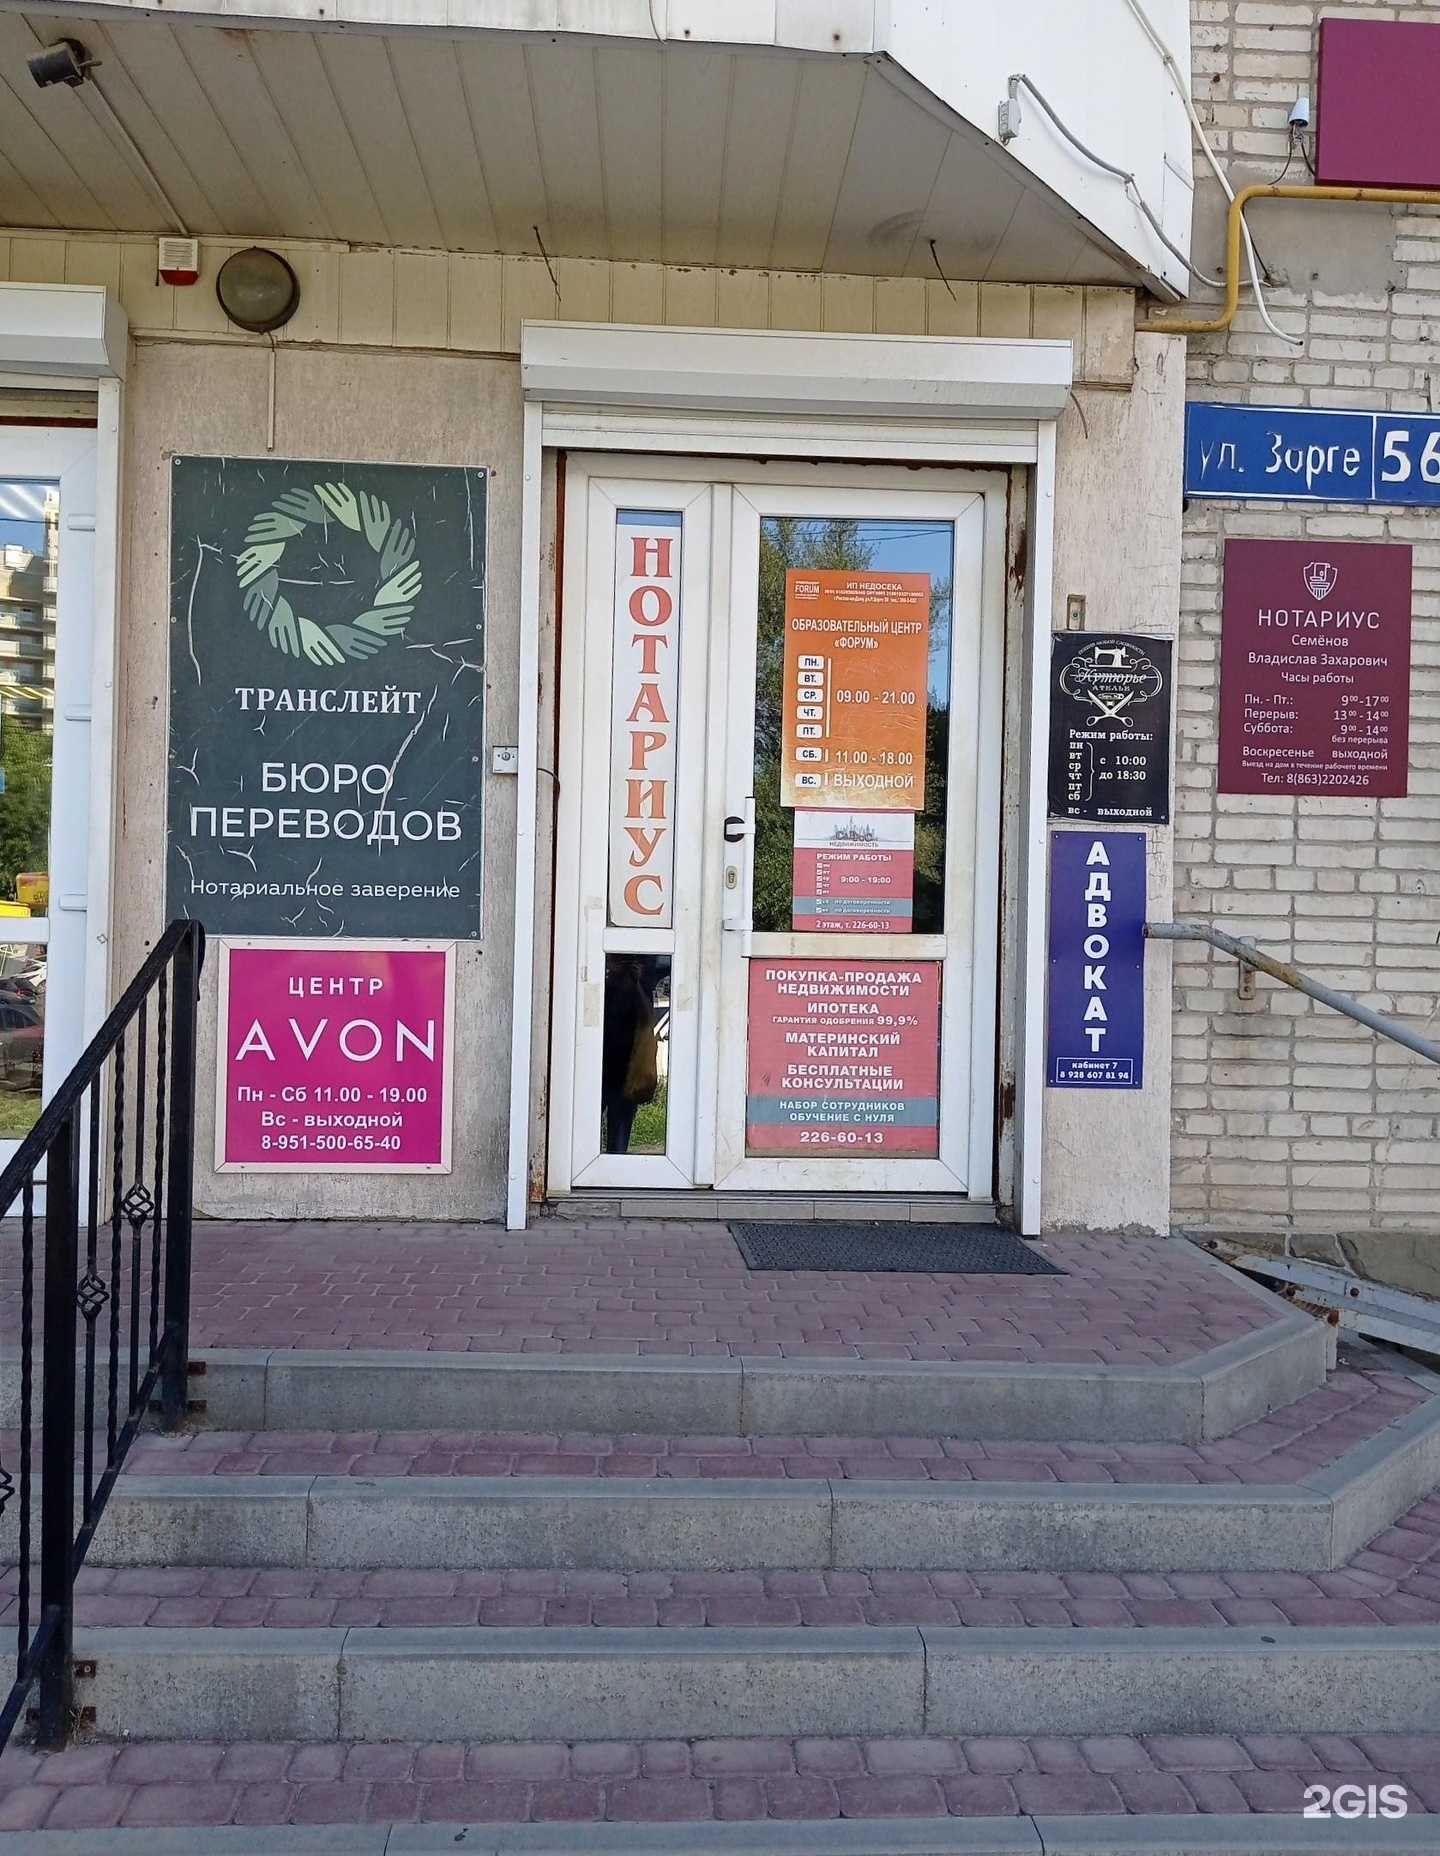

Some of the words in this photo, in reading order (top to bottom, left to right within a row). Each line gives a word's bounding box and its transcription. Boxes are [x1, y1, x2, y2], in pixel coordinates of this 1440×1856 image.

[1201, 440, 1245, 480] ул.
[1265, 430, 1361, 490] Зорге
[795, 584, 820, 594] FORUM
[860, 583, 903, 591] НЕДОСЕКА
[1258, 609, 1380, 629] НОТАРИУС
[792, 618, 889, 633] ОБРАЗОВАТЕЛЬНЫЙ
[891, 621, 922, 635] ЦЕНТР
[834, 637, 879, 649] «ФОРУМ»
[1291, 634, 1349, 647] Семёнов
[804, 658, 820, 667] ПН.
[1248, 652, 1317, 667] Владислав
[1320, 654, 1388, 668] Захарович
[804, 674, 817, 683] ВТ.
[1281, 672, 1310, 683] Часы
[1313, 672, 1354, 685] работы
[235, 685, 421, 714] ТРАНСЛЕЙТ
[803, 691, 817, 700] СР.
[836, 690, 870, 704] 09.00
[881, 691, 915, 705] 21.00
[1245, 694, 1263, 704] Пн.
[1273, 694, 1294, 705] Пт.:
[803, 708, 816, 717] ЧТ.
[1244, 709, 1299, 722] Перерыв:
[623, 536, 673, 916] НОТАРИУС
[802, 727, 816, 735] ПТ.
[1243, 723, 1294, 735] Суббота:
[1069, 729, 1106, 740] Режим
[1109, 731, 1153, 742] работы:
[1332, 735, 1346, 743] без
[1348, 737, 1388, 745] перерыва
[1069, 742, 1083, 750] пн
[802, 750, 818, 759] СБ.
[836, 751, 868, 764] 11.00
[879, 752, 913, 765] 18.00
[1069, 752, 1083, 760] вт
[1243, 746, 1315, 759] Воскресенье
[1332, 748, 1388, 760] выходной
[1068, 762, 1082, 772] ср
[1100, 757, 1106, 765] с
[1115, 756, 1147, 766] 10:00
[1242, 760, 1264, 768] Выезд
[1325, 763, 1356, 771] рабочего
[262, 762, 393, 794] БЮРО
[801, 777, 817, 785] ВС.
[834, 773, 914, 789] ВЫХОДНОЙ
[1068, 772, 1082, 780] чт
[1099, 772, 1113, 781] до
[1116, 771, 1147, 780] 18:30
[1262, 773, 1284, 784] Тел:
[1286, 774, 1370, 786] 8(863)2202426
[1068, 783, 1083, 791] пт
[1068, 791, 1081, 801] сб
[1067, 806, 1081, 815] вс
[1097, 806, 1153, 818] выходной
[190, 806, 462, 846] ПЕРЕВОДОВ
[816, 853, 851, 861] РЕЖИМ
[853, 854, 892, 862] РАБОТЫ
[191, 880, 343, 899] Нотариальное
[351, 882, 460, 900] заверение
[853, 921, 890, 930] 226-60-13
[1084, 841, 1112, 1052] АДВОКАТ
[766, 970, 922, 985] ПОКУПКА-ПРОДАЖА
[288, 976, 384, 998] ЦЕНТР
[777, 984, 909, 996] НЕДВИЖИМОСТИ
[807, 1003, 880, 1014] ИПОТЕКА
[772, 1016, 817, 1024] ГАРАНТИЯ
[820, 1017, 875, 1026] ОДОБРЕНИЯ
[877, 1015, 918, 1026] 99,9%
[235, 1018, 435, 1062] AVON
[785, 1032, 900, 1045] МАТЕРИНСКИЙ
[807, 1046, 878, 1057] КАПИТАЛ
[787, 1064, 893, 1076] БЕСПЛАТНЫЕ
[1072, 1061, 1110, 1069] кабинет
[1068, 1071, 1084, 1079] 928
[1087, 1071, 1103, 1079] 607
[781, 1077, 904, 1091] КОНСУЛЬТАЦИИ
[237, 1086, 263, 1101] Пн
[281, 1086, 307, 1102] Сб
[314, 1087, 361, 1102] 11.00
[379, 1087, 427, 1103] 19.00
[780, 1101, 818, 1109] НАБОР
[821, 1101, 905, 1111] СОТРУДНИКОВ
[261, 1111, 286, 1127] Вс
[304, 1111, 403, 1128] выходной
[789, 1112, 849, 1122] ОБУЧЕНИЕ
[853, 1113, 861, 1121] С
[865, 1114, 895, 1122] НУЛЯ
[261, 1135, 400, 1150] 8-951-500-65-40
[800, 1131, 884, 1143] 226-60-13
